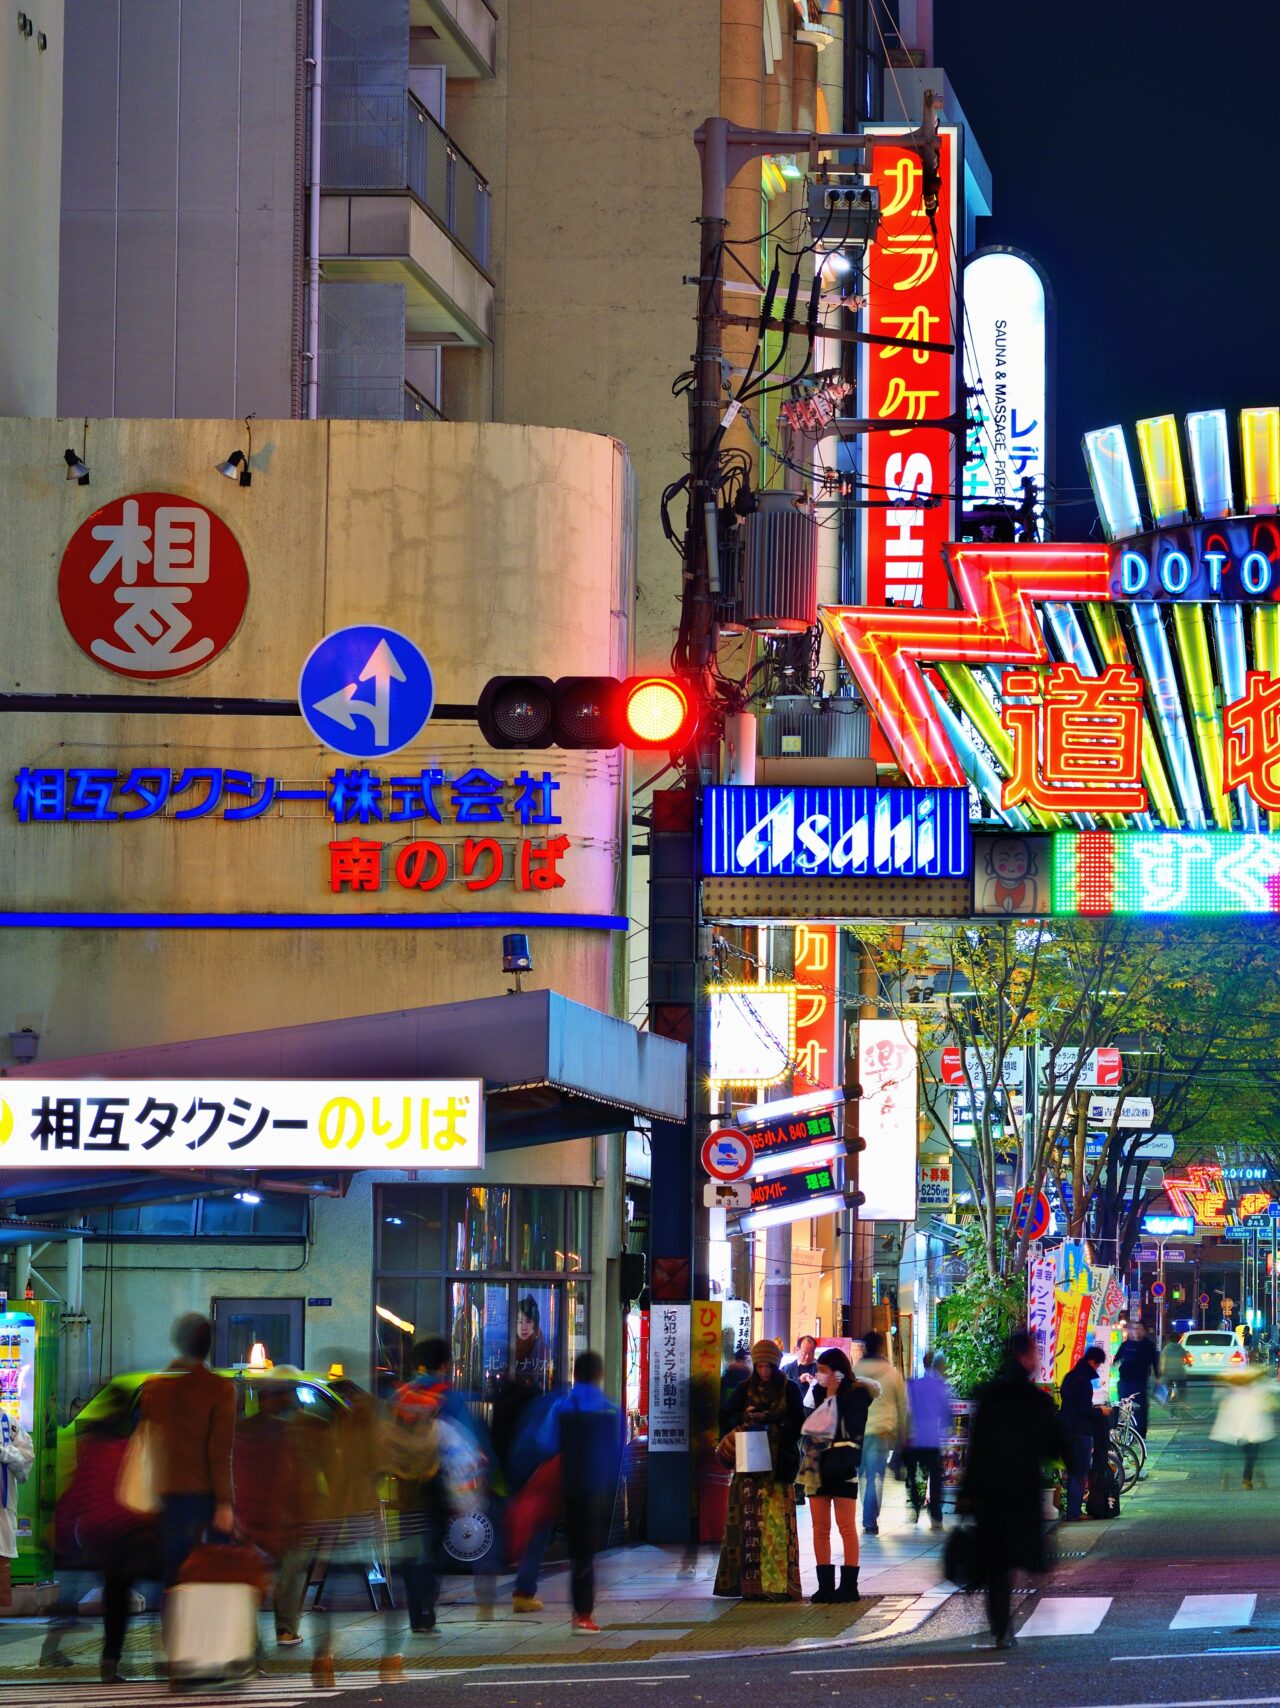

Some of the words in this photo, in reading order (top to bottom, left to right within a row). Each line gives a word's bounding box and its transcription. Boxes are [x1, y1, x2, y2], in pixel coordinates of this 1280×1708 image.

[877, 158, 940, 437] カラオケ
[995, 319, 1007, 367] SAUNA
[995, 371, 1007, 381] &
[13, 767, 562, 825] 相互タクシー株式会社
[735, 792, 935, 868] Asahi
[328, 833, 572, 894] 南のりば
[789, 1122, 807, 1140] 840
[806, 1117, 832, 1136] 理容
[804, 1171, 831, 1190] 理容
[663, 1309, 677, 1410] 防犯カメラ作動中
